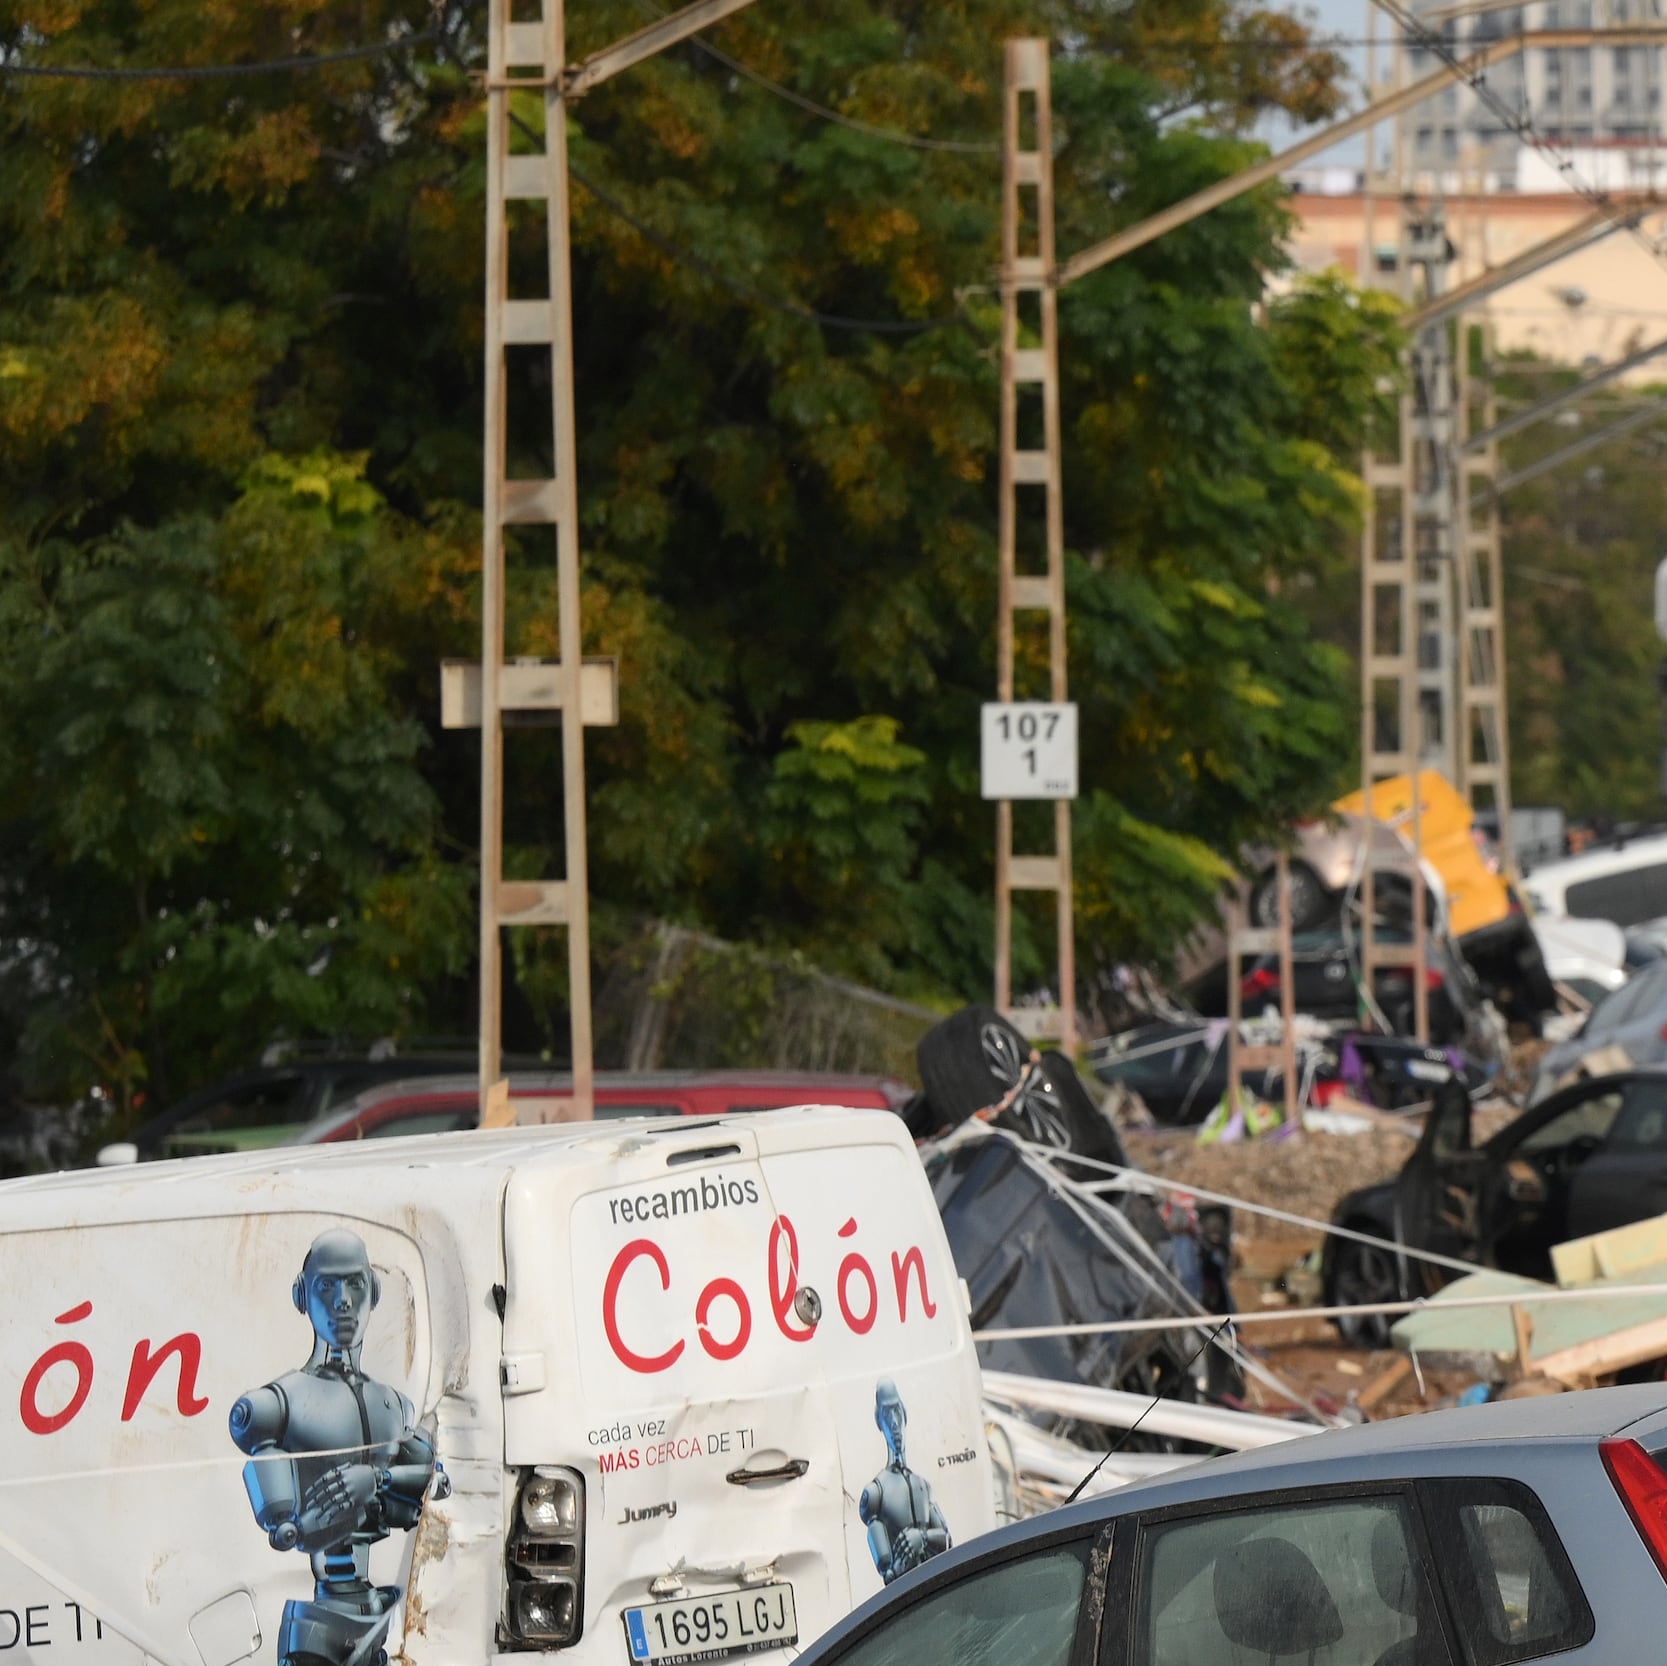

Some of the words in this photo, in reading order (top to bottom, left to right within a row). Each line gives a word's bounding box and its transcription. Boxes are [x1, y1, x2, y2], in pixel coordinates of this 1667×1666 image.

[995, 712, 1061, 741] 107
[1022, 748, 1036, 775] 1
[609, 1174, 759, 1224] recambios
[603, 1214, 937, 1373] Colón
[588, 1422, 632, 1446] cada
[637, 1420, 666, 1439] vez
[599, 1446, 640, 1474] MÁS
[645, 1437, 703, 1467] CERCA
[707, 1432, 731, 1455] DE
[736, 1429, 754, 1449] TI
[654, 1604, 729, 1649] 1695
[736, 1593, 786, 1637] LGJ
[657, 1653, 689, 1666] Autos
[690, 1648, 729, 1663] Lorente
